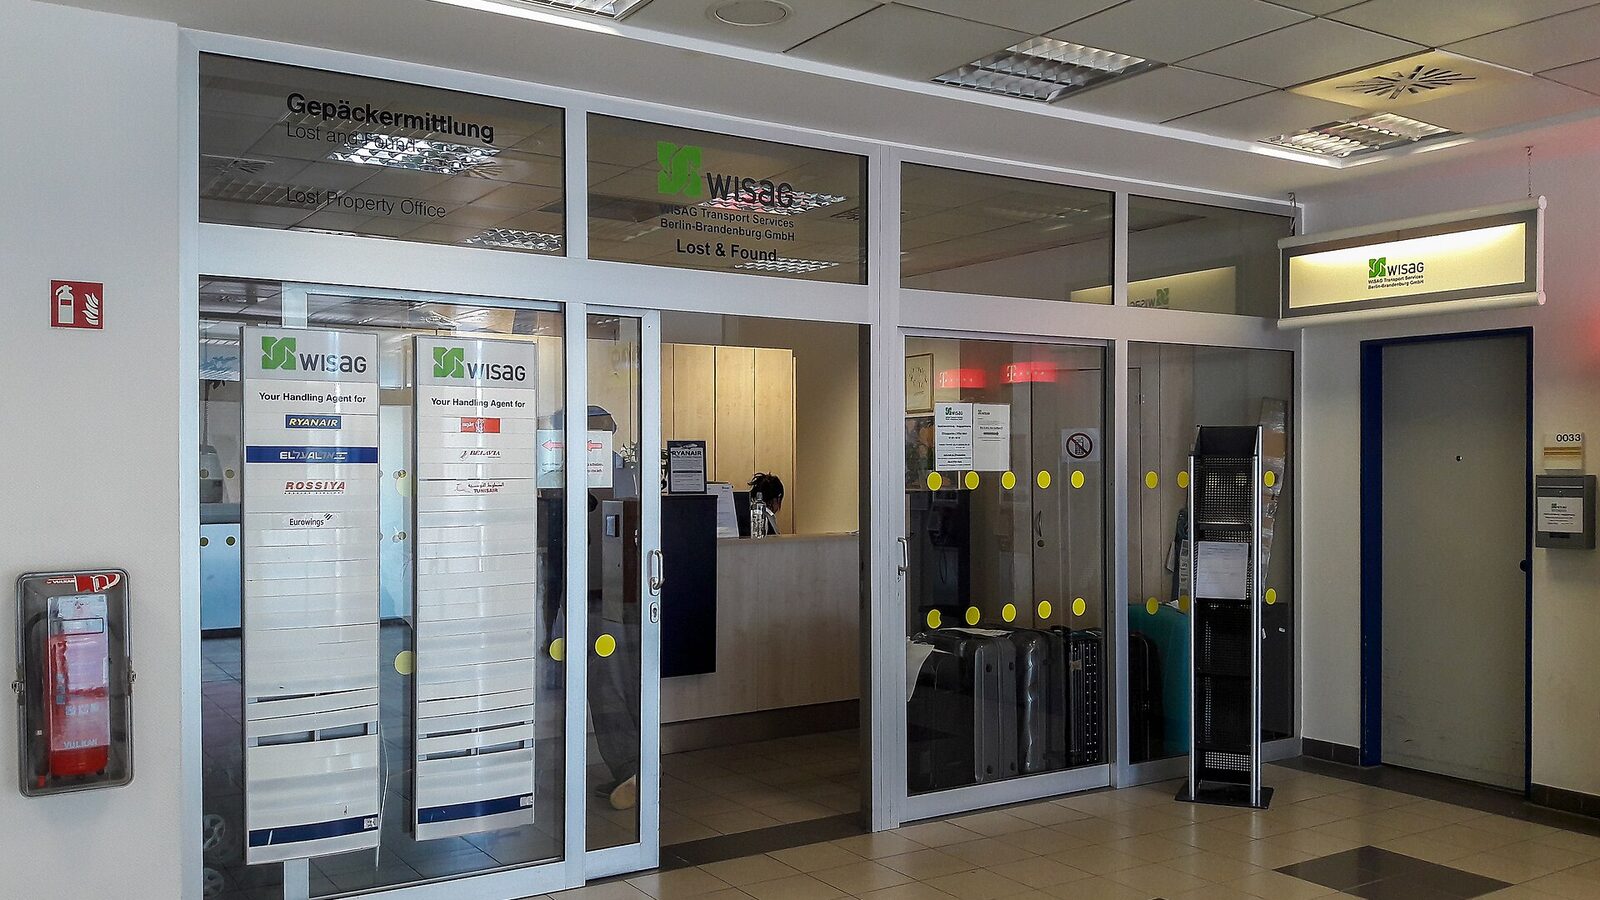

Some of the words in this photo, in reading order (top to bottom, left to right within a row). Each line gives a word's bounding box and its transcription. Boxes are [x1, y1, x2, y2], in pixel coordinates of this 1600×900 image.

[286, 92, 494, 143] Gepäckermittlung
[287, 122, 324, 142] Lost
[327, 127, 358, 146] and
[363, 131, 415, 152] Found
[287, 187, 322, 204] Lost
[327, 190, 395, 215] Property
[400, 199, 447, 219] Office
[660, 204, 698, 217] WISAG
[701, 208, 750, 224] Transport
[753, 215, 794, 228] Services
[660, 218, 762, 241] Berlin-Brandenburg
[764, 229, 795, 242] GmbH
[676, 238, 711, 255] Lost
[715, 242, 727, 257] &
[730, 244, 777, 262] Found
[1368, 281, 1410, 289] Berlin-Brandenburg
[259, 392, 281, 401] Your
[283, 393, 323, 403] Handling
[326, 394, 352, 404] Agent
[354, 394, 366, 403] for
[431, 398, 450, 406] Your
[452, 398, 488, 408] Handling
[491, 400, 513, 408] Agent
[288, 418, 338, 427] RYANAIR
[1556, 434, 1581, 442] 0033
[285, 481, 345, 490] ROSSIYA
[289, 518, 325, 527] Eurowings
